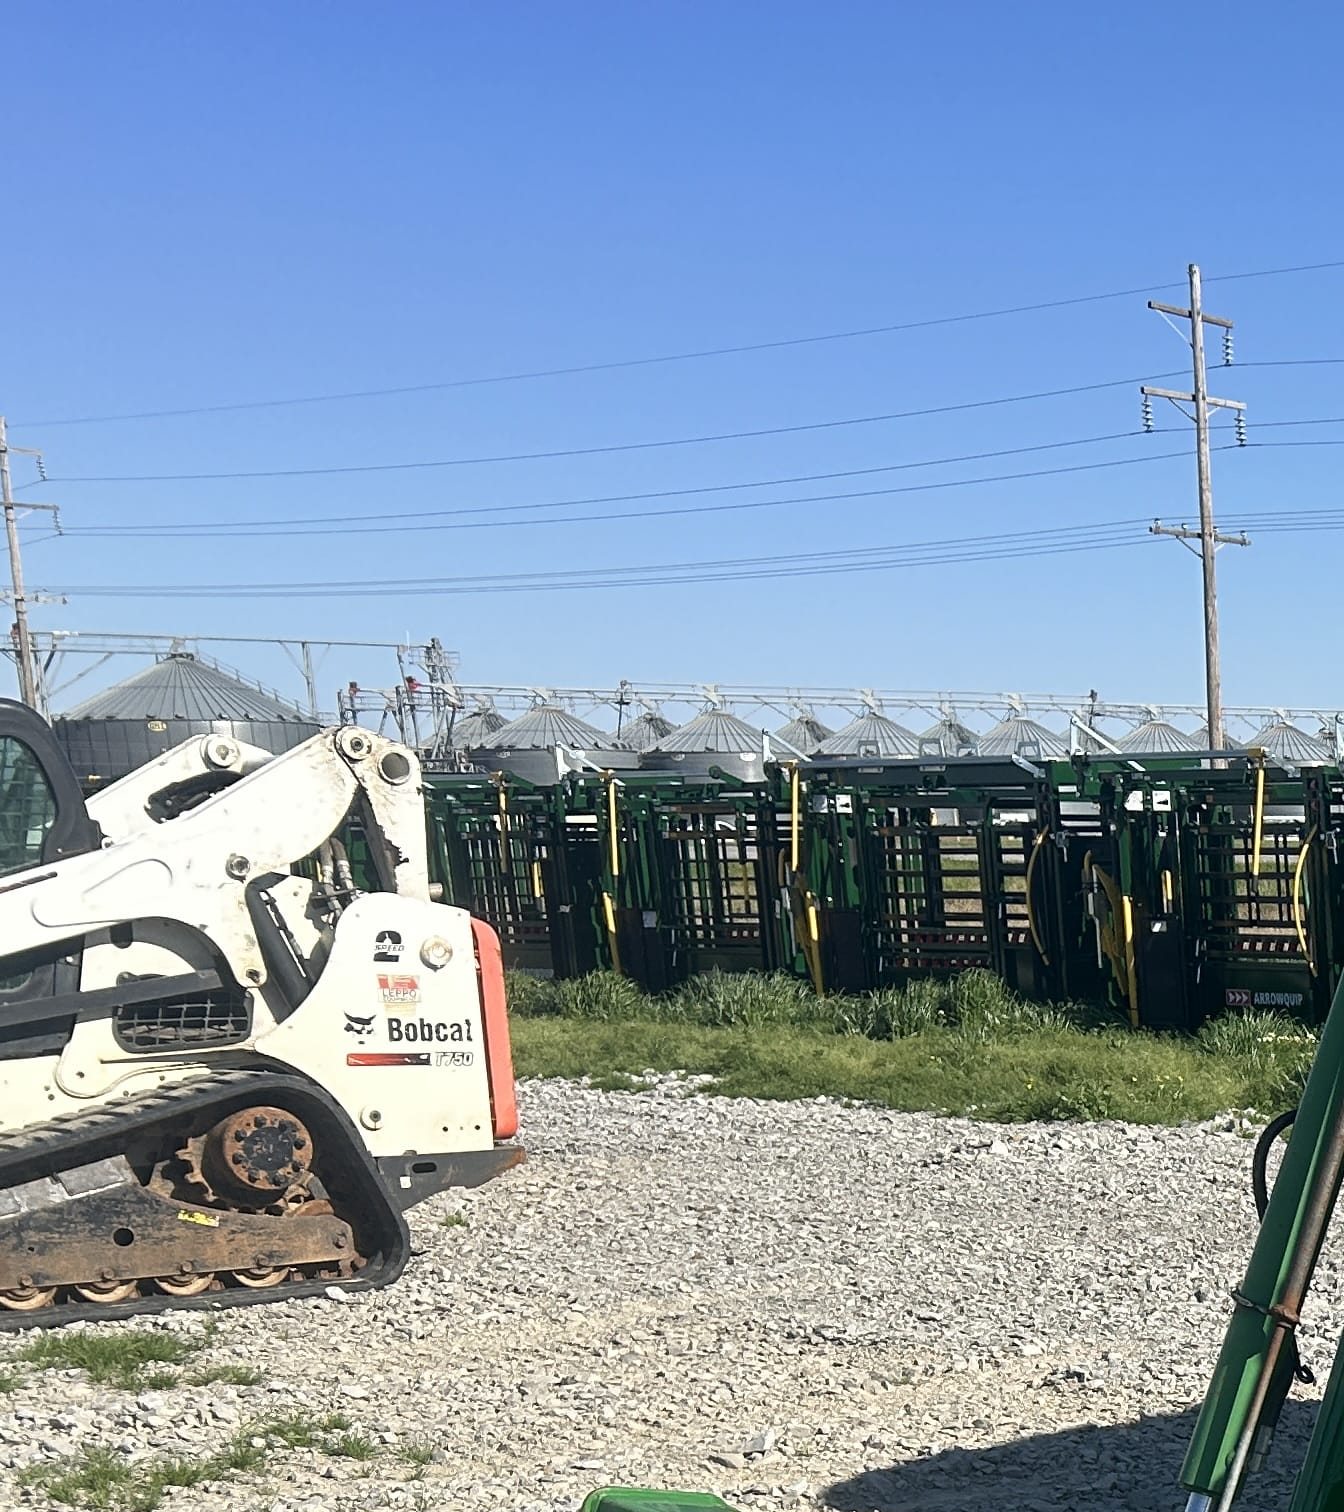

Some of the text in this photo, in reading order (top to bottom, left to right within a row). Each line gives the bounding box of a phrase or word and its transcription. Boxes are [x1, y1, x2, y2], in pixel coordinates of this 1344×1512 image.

[1253, 992, 1303, 1008] ARROWQUIP
[387, 1017, 473, 1042] Bobcat
[435, 1051, 474, 1067] T750
